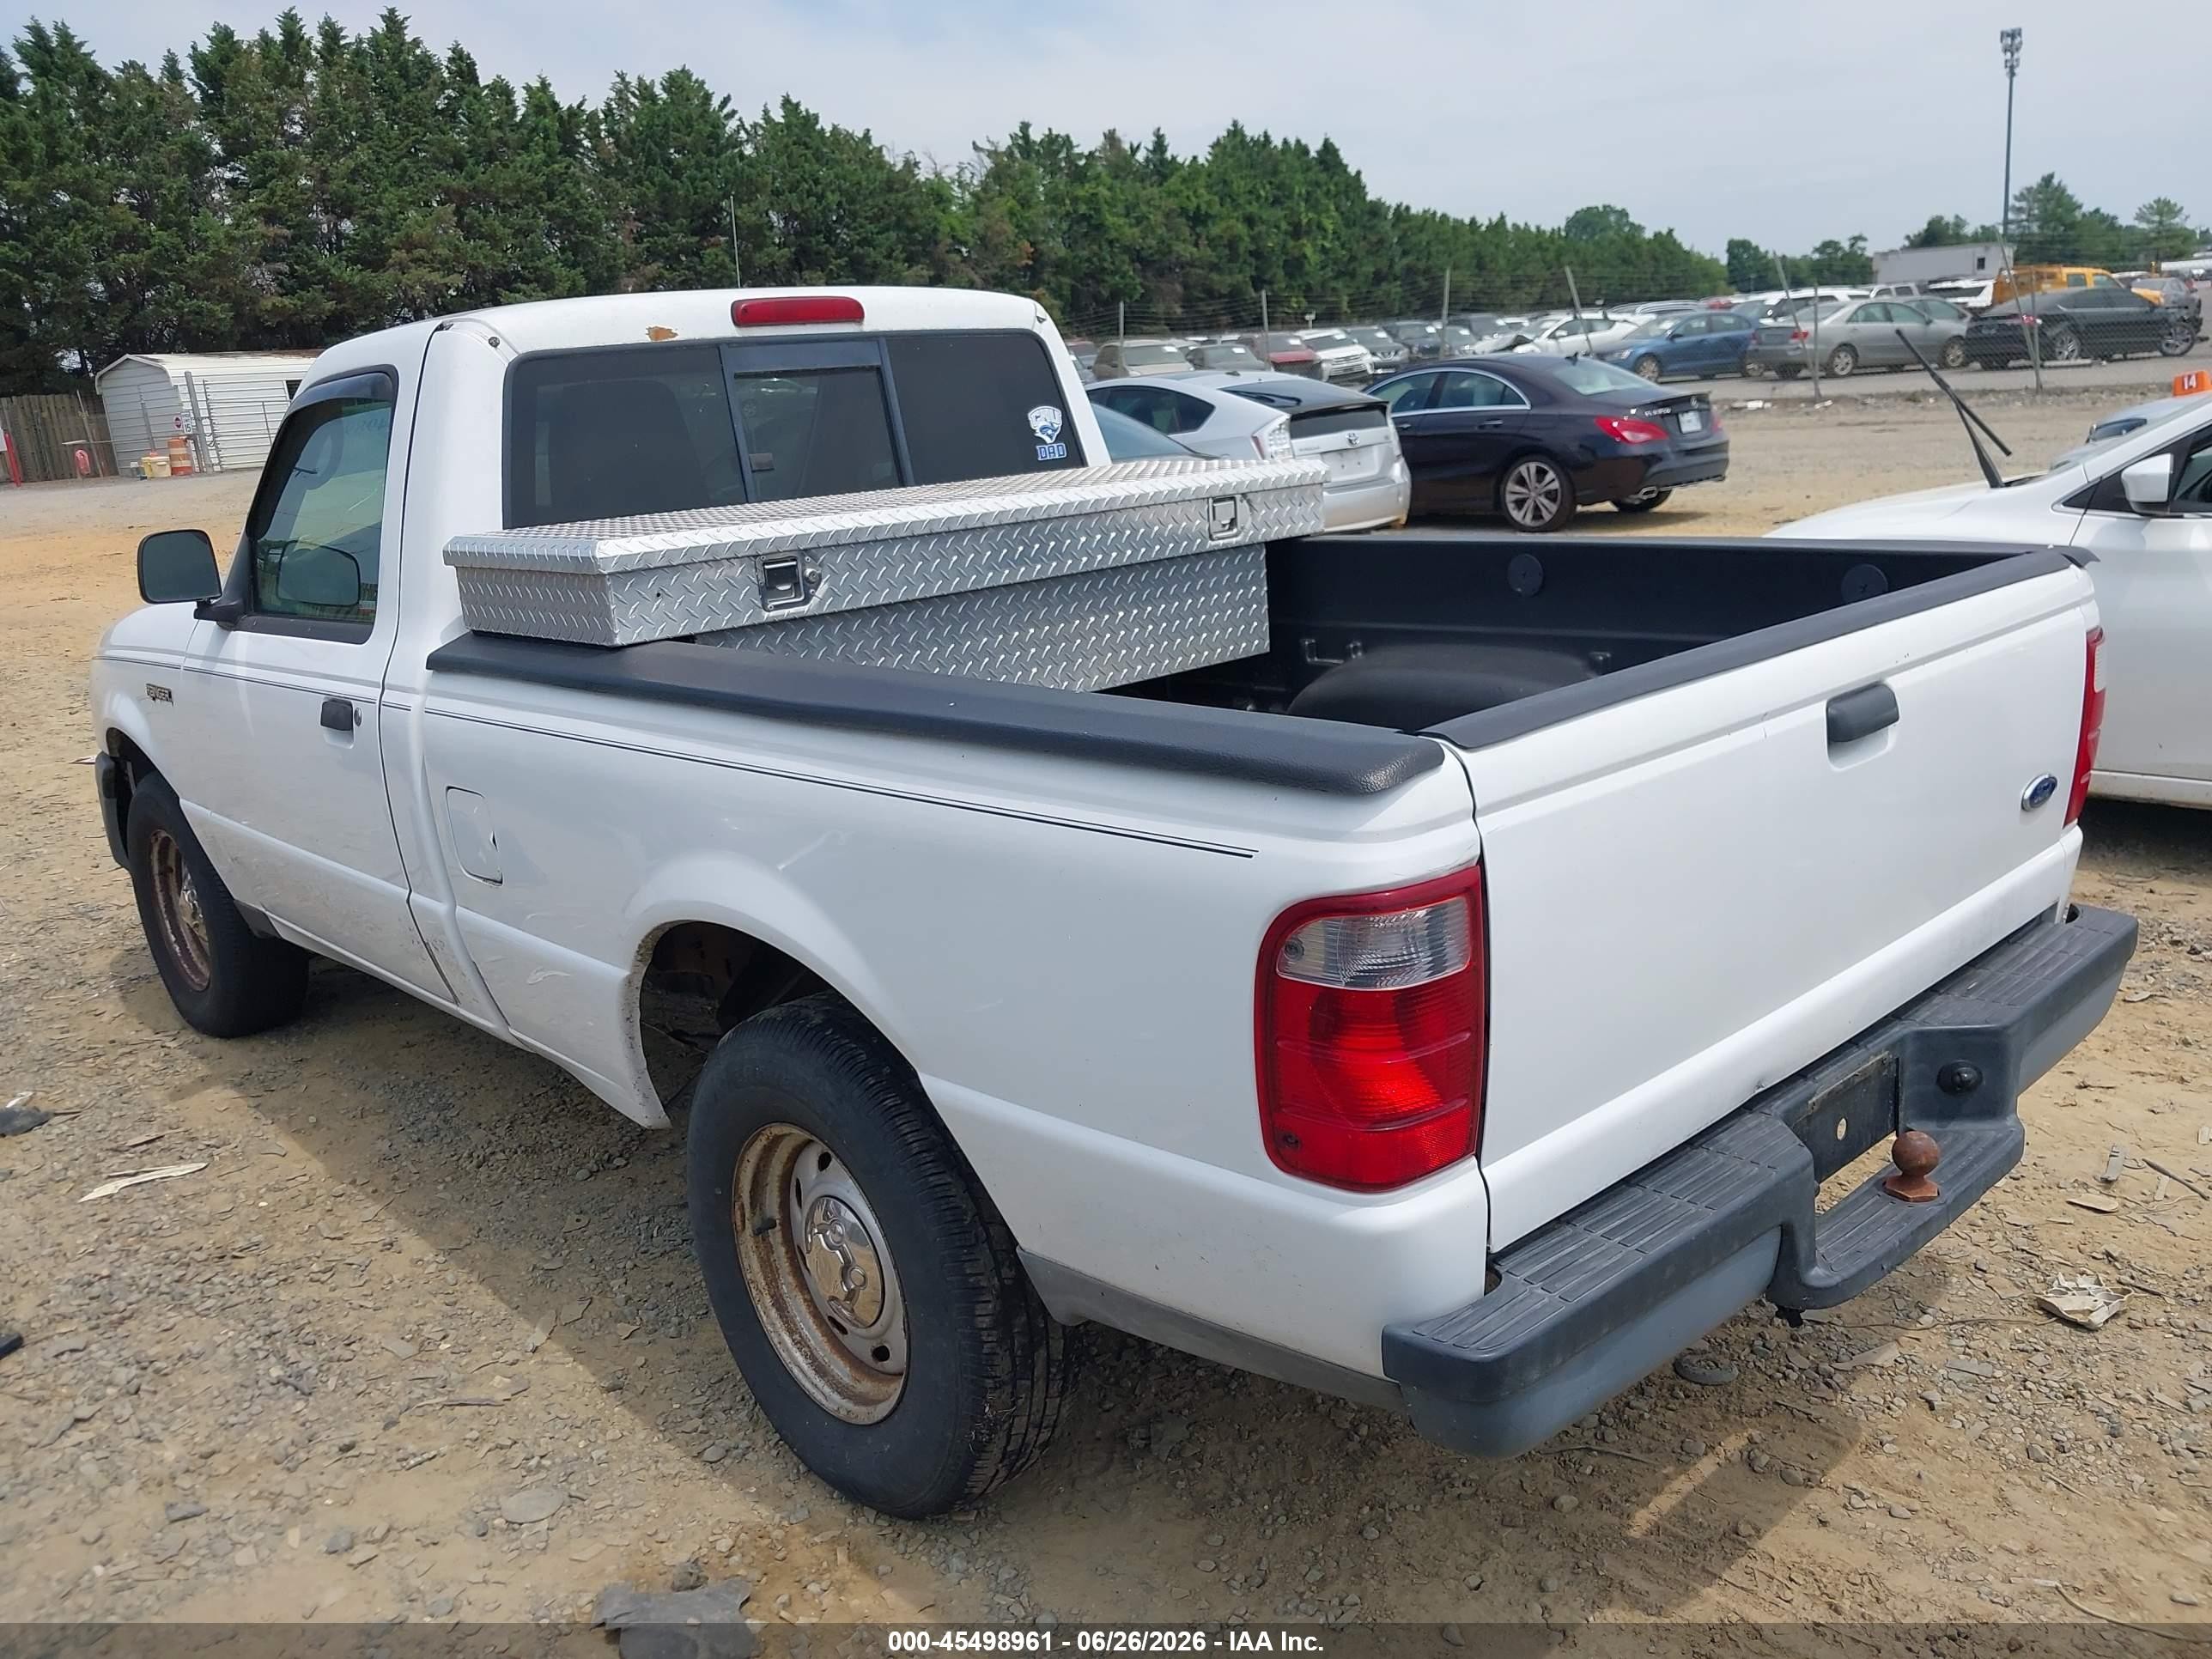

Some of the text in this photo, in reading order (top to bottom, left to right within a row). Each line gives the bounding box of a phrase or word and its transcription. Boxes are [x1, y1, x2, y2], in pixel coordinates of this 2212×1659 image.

[2184, 374, 2197, 390] 14
[184, 423, 191, 433] 15
[1037, 444, 1066, 459] DAD
